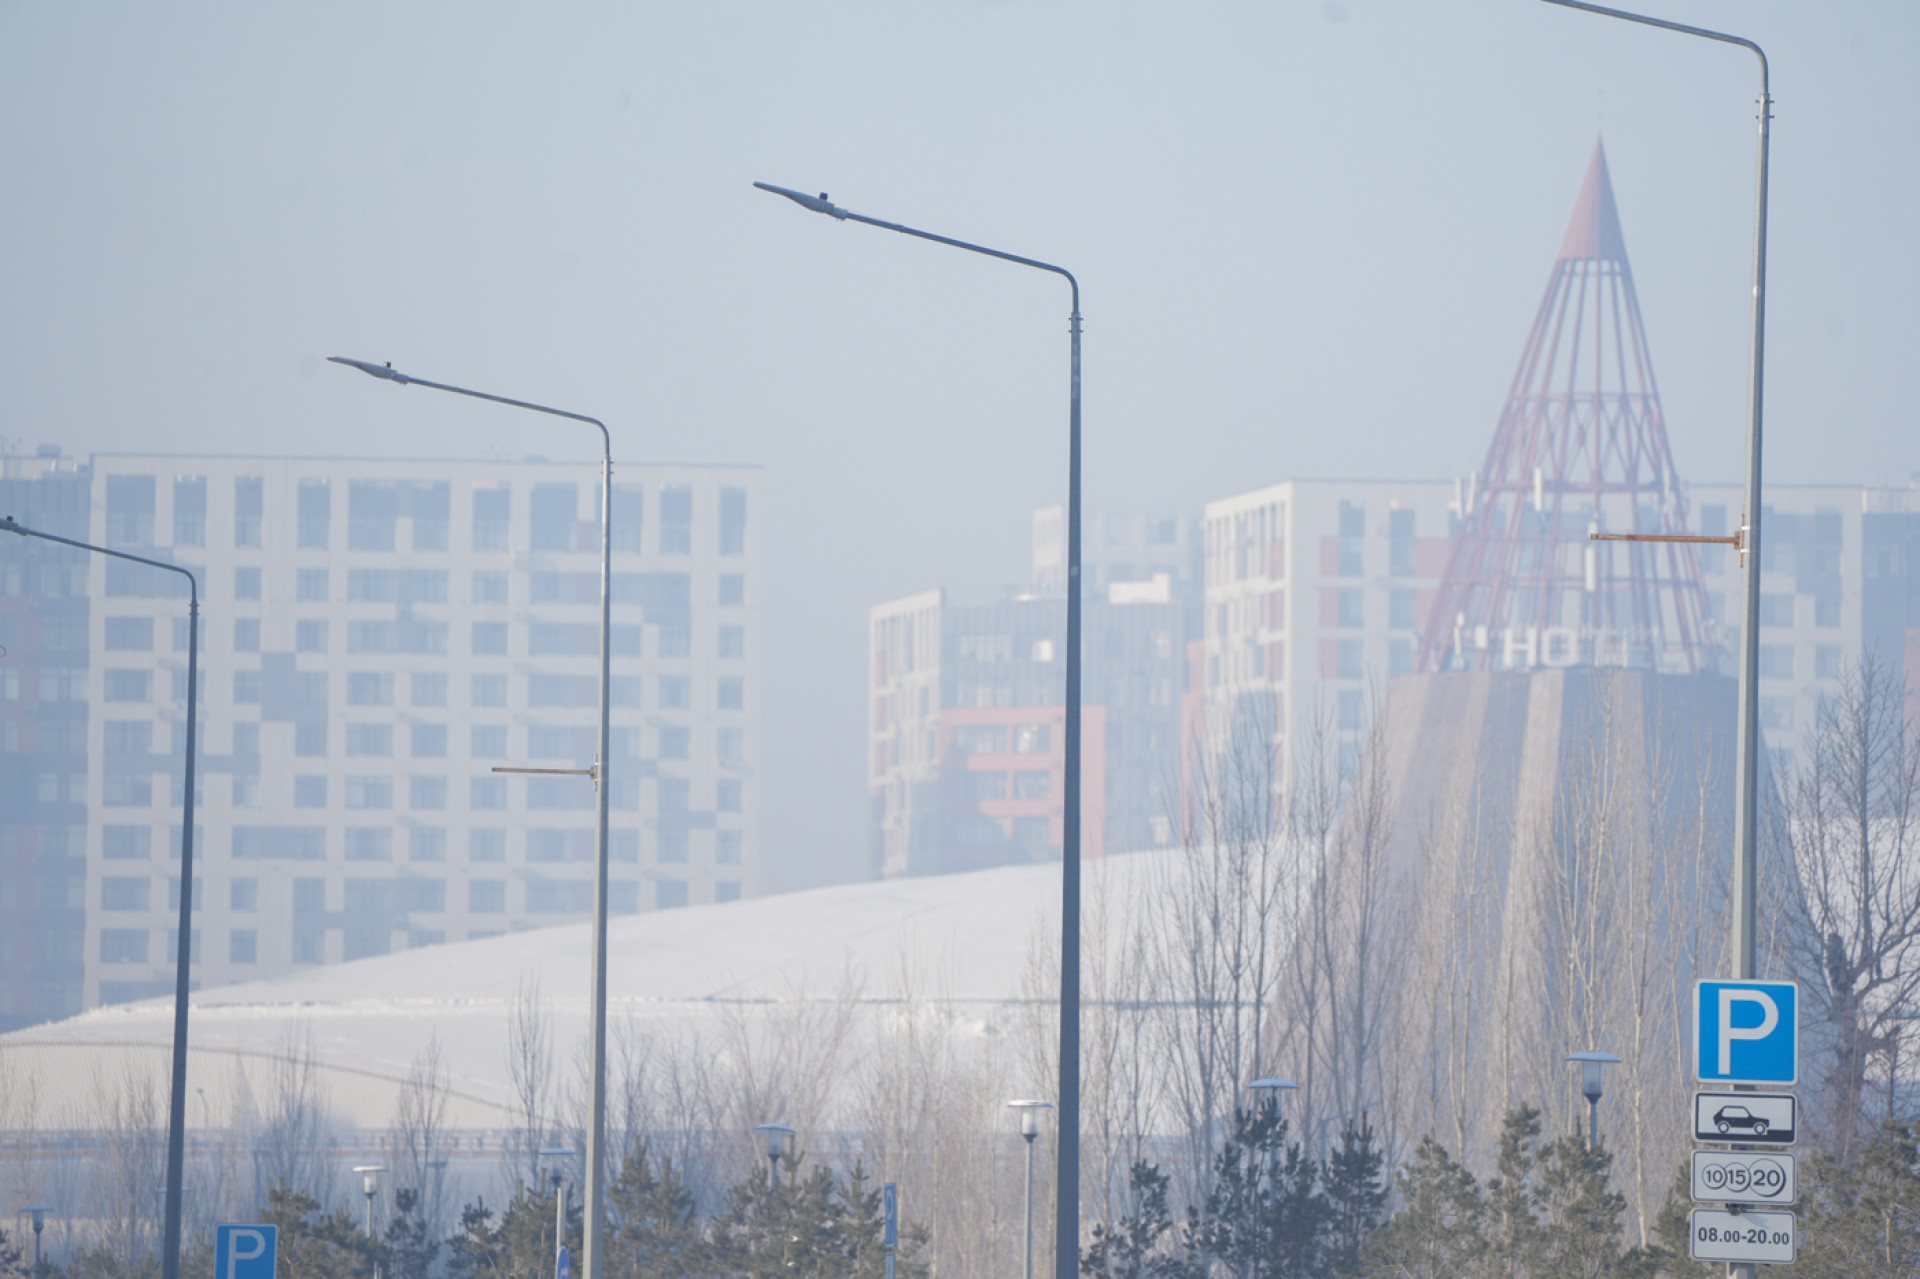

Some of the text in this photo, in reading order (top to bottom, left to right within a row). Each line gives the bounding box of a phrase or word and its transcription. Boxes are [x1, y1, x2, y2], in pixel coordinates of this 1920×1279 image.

[1717, 988, 1779, 1075] P
[1706, 1169, 1780, 1187] 10 15 20
[1698, 1227, 1789, 1245] 08.00-20.00
[227, 1229, 266, 1279] P
